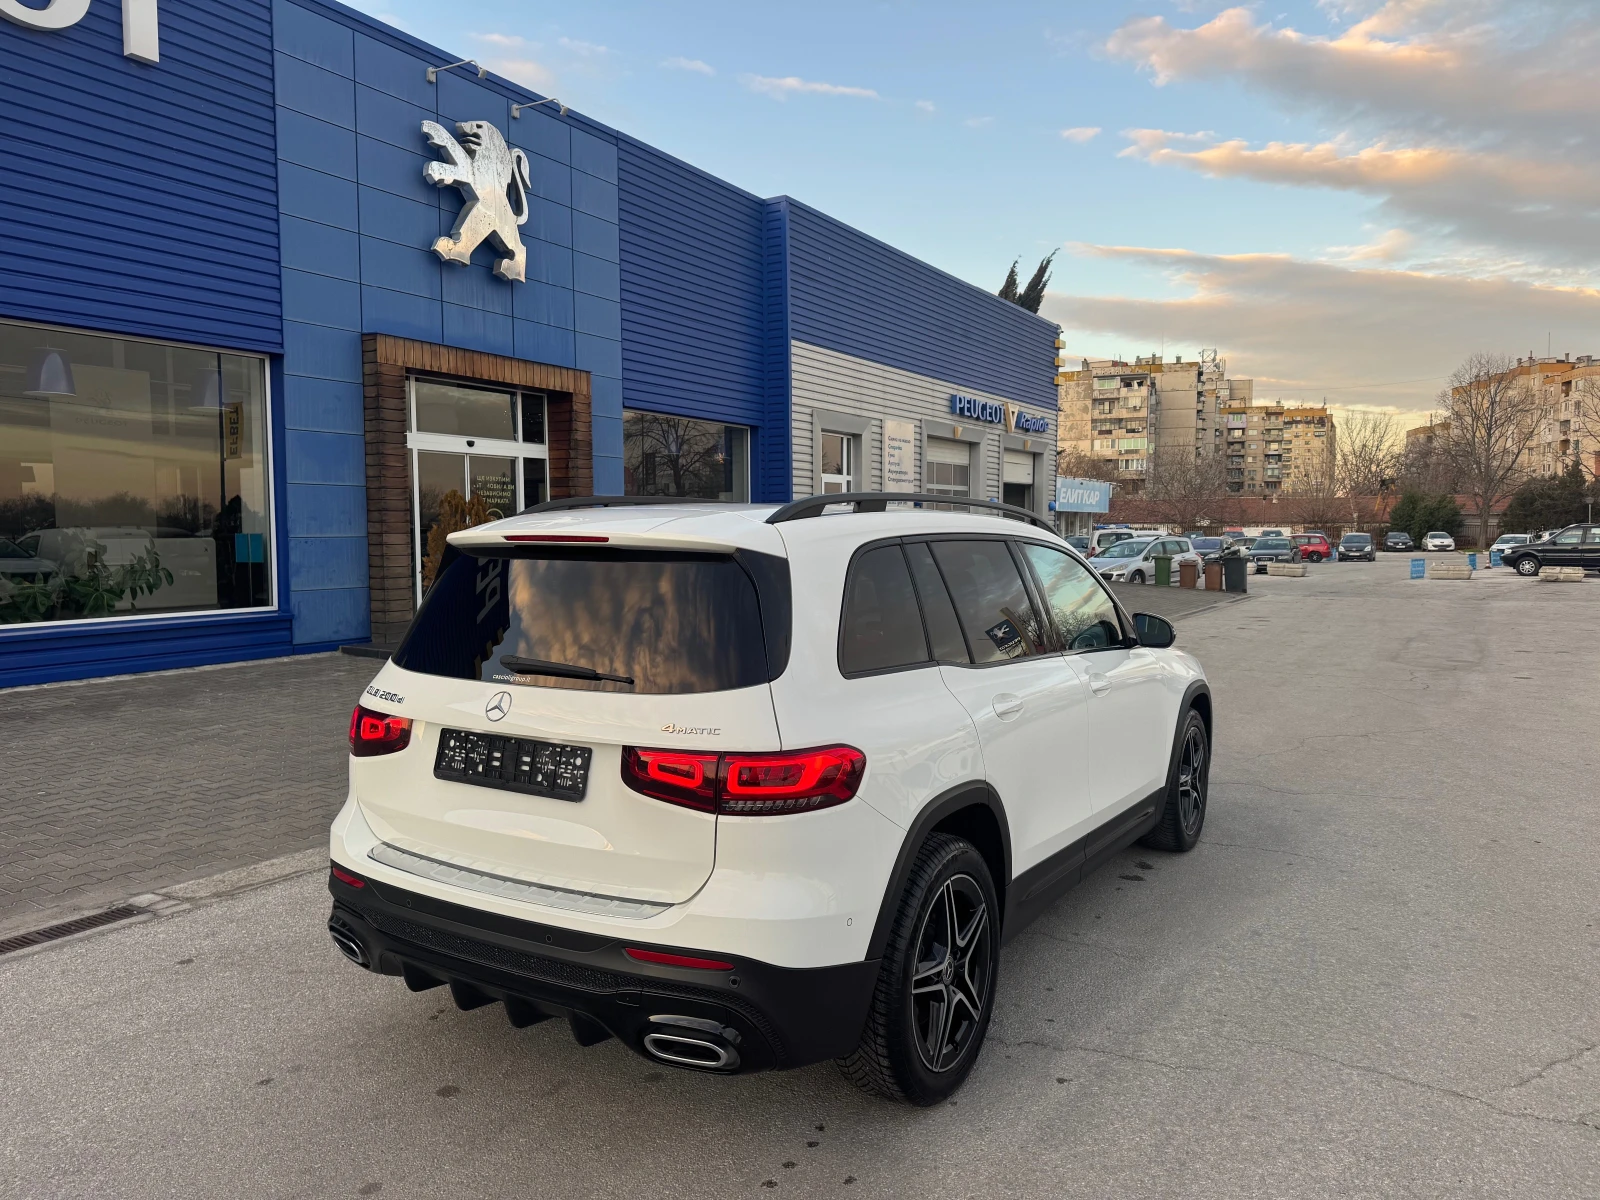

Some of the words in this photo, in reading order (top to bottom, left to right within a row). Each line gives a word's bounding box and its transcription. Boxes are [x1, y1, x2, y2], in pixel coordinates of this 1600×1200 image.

[954, 394, 1004, 424] PEUGEOT
[1059, 487, 1100, 505] ЕЛИТКАР
[660, 723, 722, 736] 4MATIC
